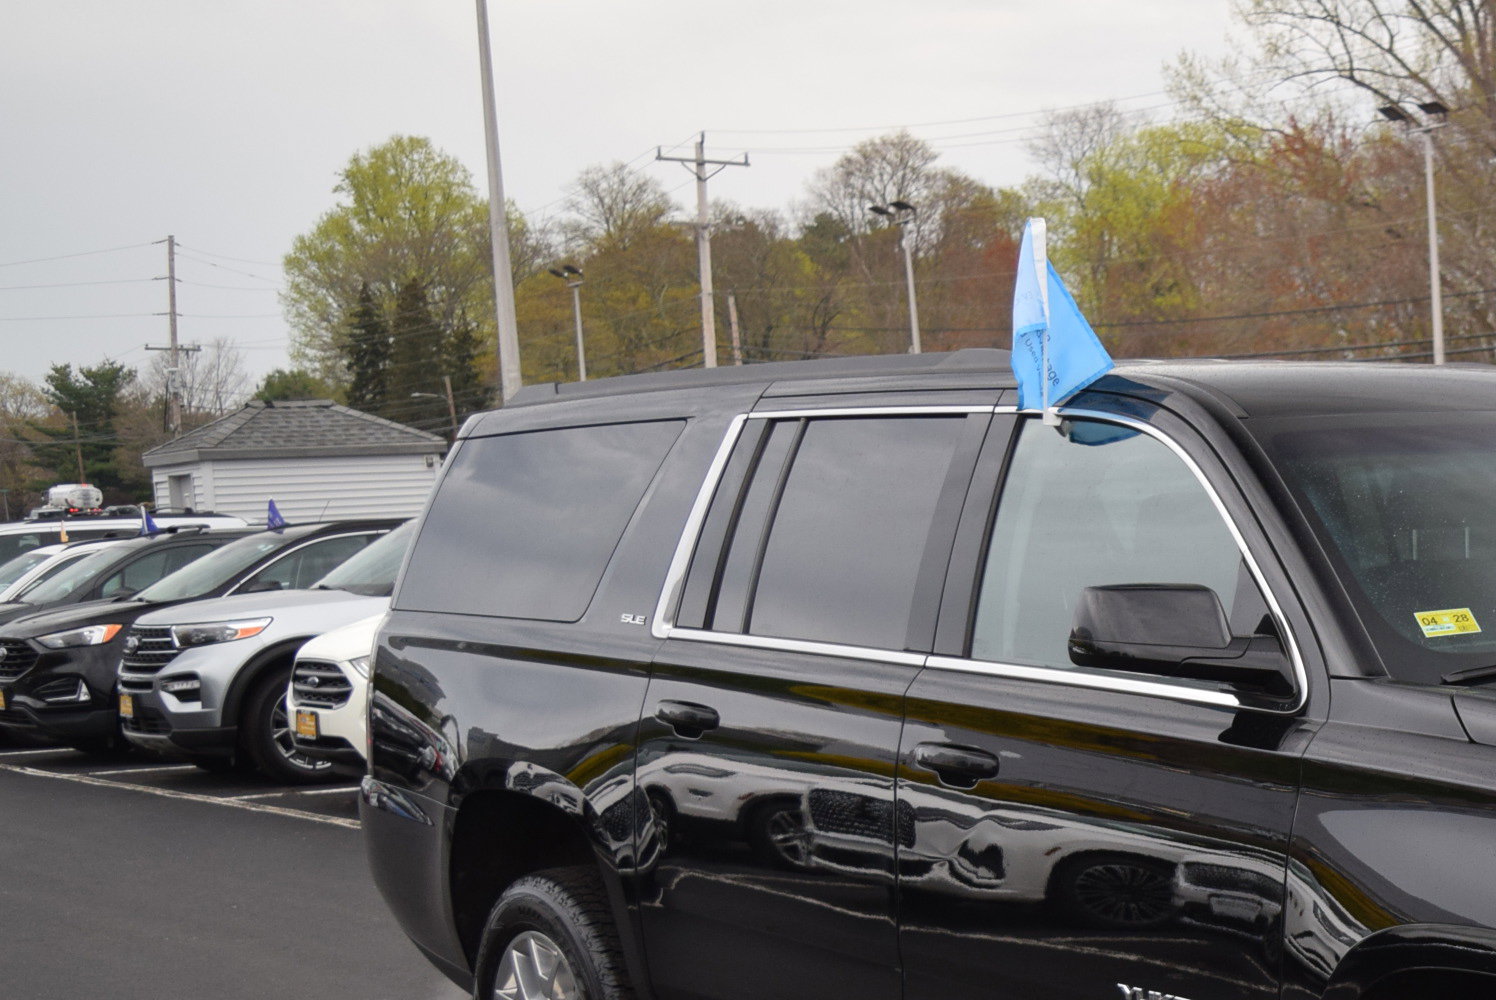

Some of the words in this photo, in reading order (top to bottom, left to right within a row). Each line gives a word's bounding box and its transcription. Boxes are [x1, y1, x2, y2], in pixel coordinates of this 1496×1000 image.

[621, 613, 646, 625] SLE
[1421, 617, 1438, 625] 04
[1452, 613, 1470, 623] 28
